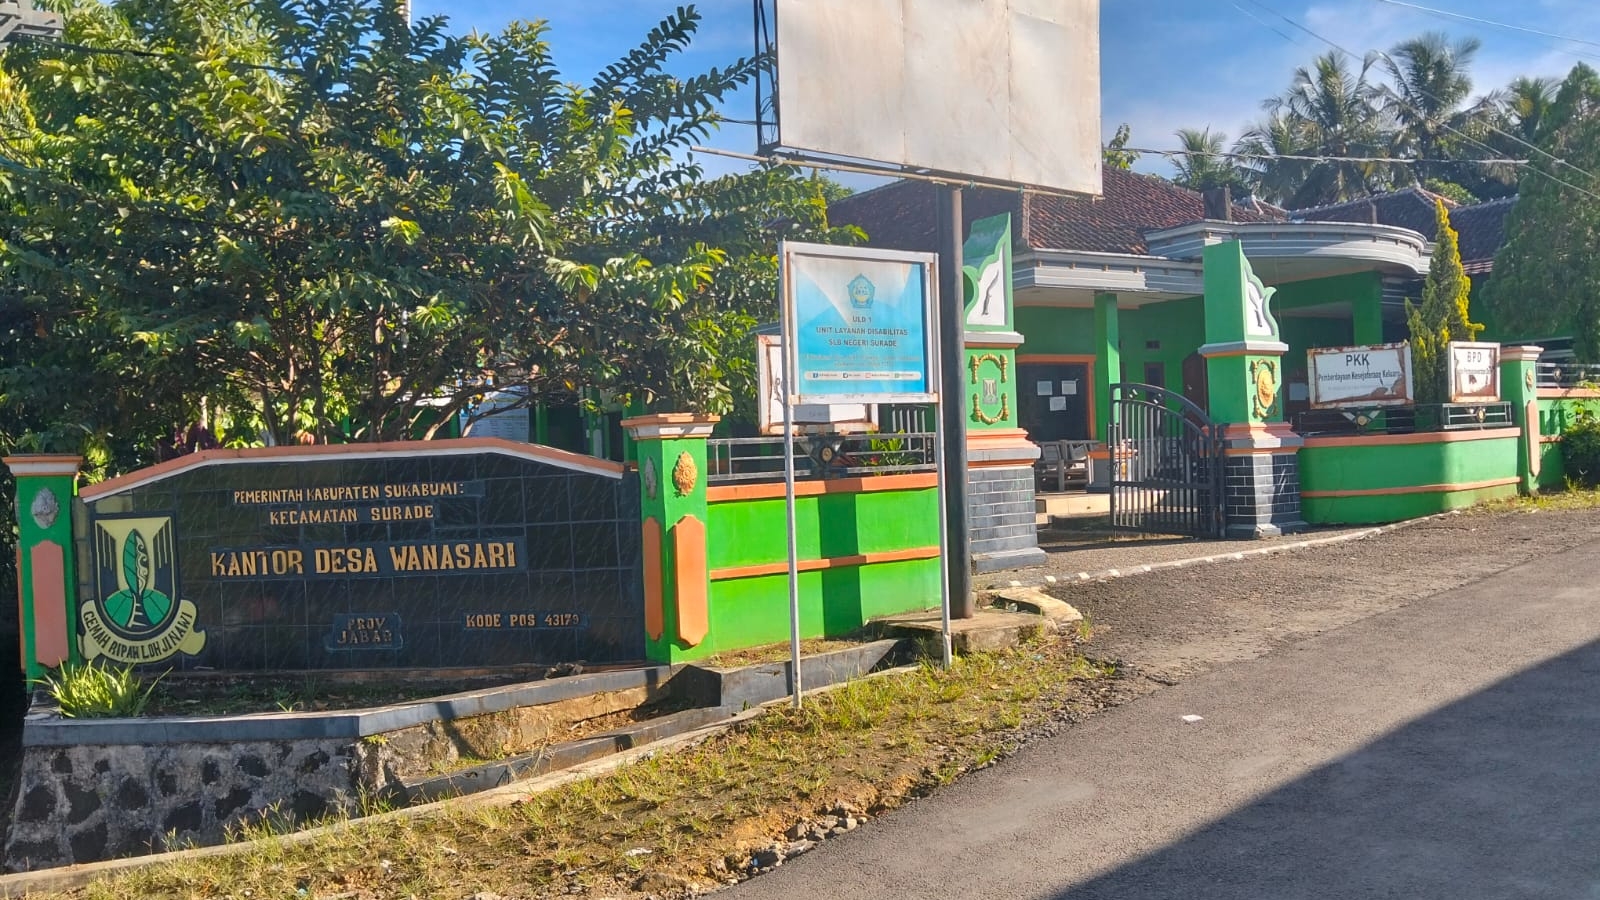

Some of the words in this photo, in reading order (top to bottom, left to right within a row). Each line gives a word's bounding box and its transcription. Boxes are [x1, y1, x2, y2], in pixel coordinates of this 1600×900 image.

[834, 327, 866, 335] LAYANAN
[867, 328, 908, 336] DISABILITAS
[844, 338, 869, 347] NEGERI
[870, 339, 897, 347] SURADE
[1345, 353, 1370, 366] PKK
[1467, 351, 1482, 363] BPD
[234, 489, 303, 504] PEMERINTAH
[307, 485, 379, 501] KABUPATEN
[269, 508, 357, 525] KECAMATAN
[371, 505, 434, 521] SURADE
[211, 549, 304, 577] KANTOR
[315, 546, 377, 574] DESA
[389, 542, 516, 571] WANASARI
[347, 617, 386, 631] PROV
[465, 613, 501, 628] KODE
[509, 613, 535, 627] POS
[544, 613, 580, 626] 43179
[83, 610, 111, 649] GEMAH
[108, 641, 140, 659] RIPAH
[141, 641, 162, 658] LOH
[162, 611, 193, 654] JINAWI
